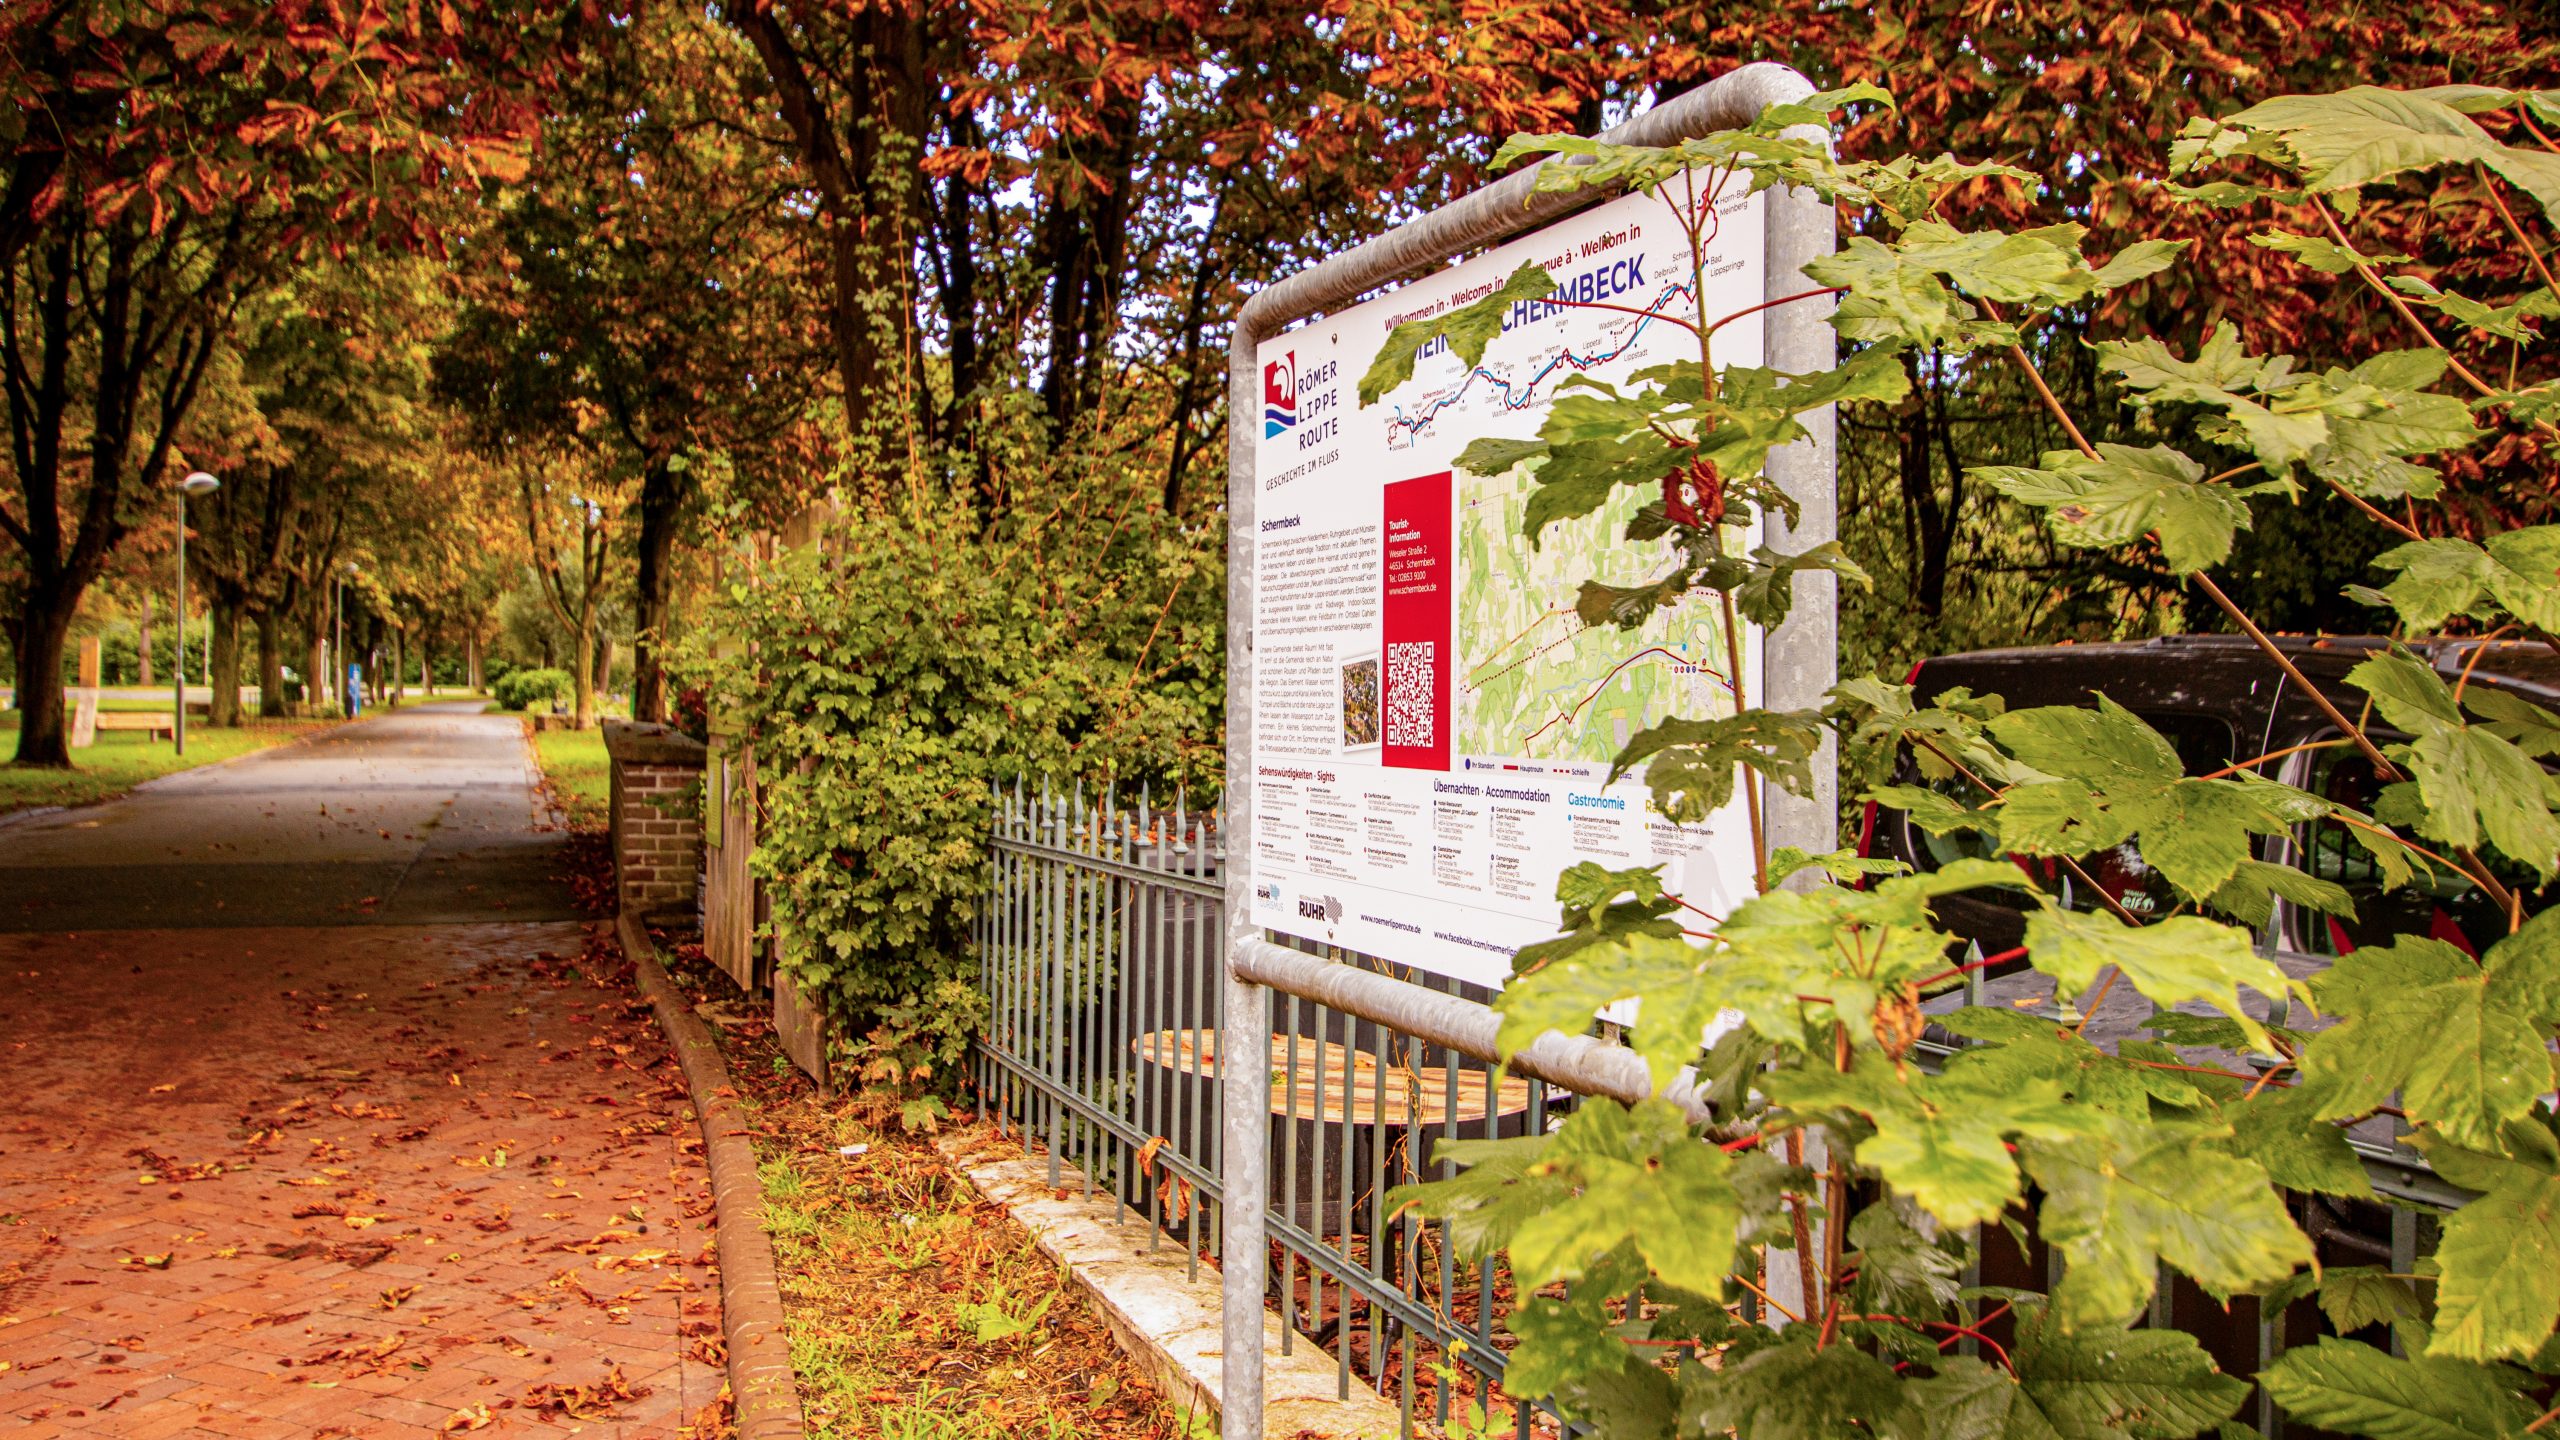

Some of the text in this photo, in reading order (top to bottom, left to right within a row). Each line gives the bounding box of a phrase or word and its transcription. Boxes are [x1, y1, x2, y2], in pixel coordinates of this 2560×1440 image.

[1720, 201, 1748, 217] Meinberg
[1710, 255, 1722, 265] Bad
[1654, 264, 1679, 280] Delbrück
[1710, 259, 1745, 278] Lippspringe
[1384, 223, 1641, 332] Willkommen in Welcome in à Welkom in
[1502, 252, 1645, 332] CHERMBECK
[1598, 317, 1625, 331] Wadersloh
[1544, 344, 1561, 354] Hamm
[1582, 338, 1603, 350] Lippetal
[1624, 349, 1648, 362] Lippstadt
[1298, 360, 1337, 396] RÖMER
[1422, 389, 1446, 399] Schermbeck
[1299, 388, 1337, 423] LIPPE
[1299, 417, 1338, 451] ROUTE
[1266, 448, 1339, 491] GESCHICHTE IM FLUSS
[1261, 514, 1301, 532] Schermbeck
[1389, 518, 1409, 531] Tourist-
[1389, 529, 1421, 543] Information
[1389, 544, 1428, 558] Weseler Straße 2
[1406, 556, 1436, 569] Schermbeck
[1389, 582, 1437, 596] www.schermbeck.de
[1259, 765, 1335, 783] Sehenswürdigkeiten Sights
[1477, 762, 1495, 770] Standort
[1519, 765, 1544, 773] Hauptroute
[1571, 768, 1589, 777] Schleife
[1433, 778, 1551, 803] Übernachten Accommodation
[1568, 792, 1625, 810] Gastronomie
[1699, 828, 1714, 836] Spahn
[1258, 889, 1271, 900] RUHR
[1298, 900, 1326, 922] RUHR
[1360, 913, 1421, 935] www.roemerlipperoute.de
